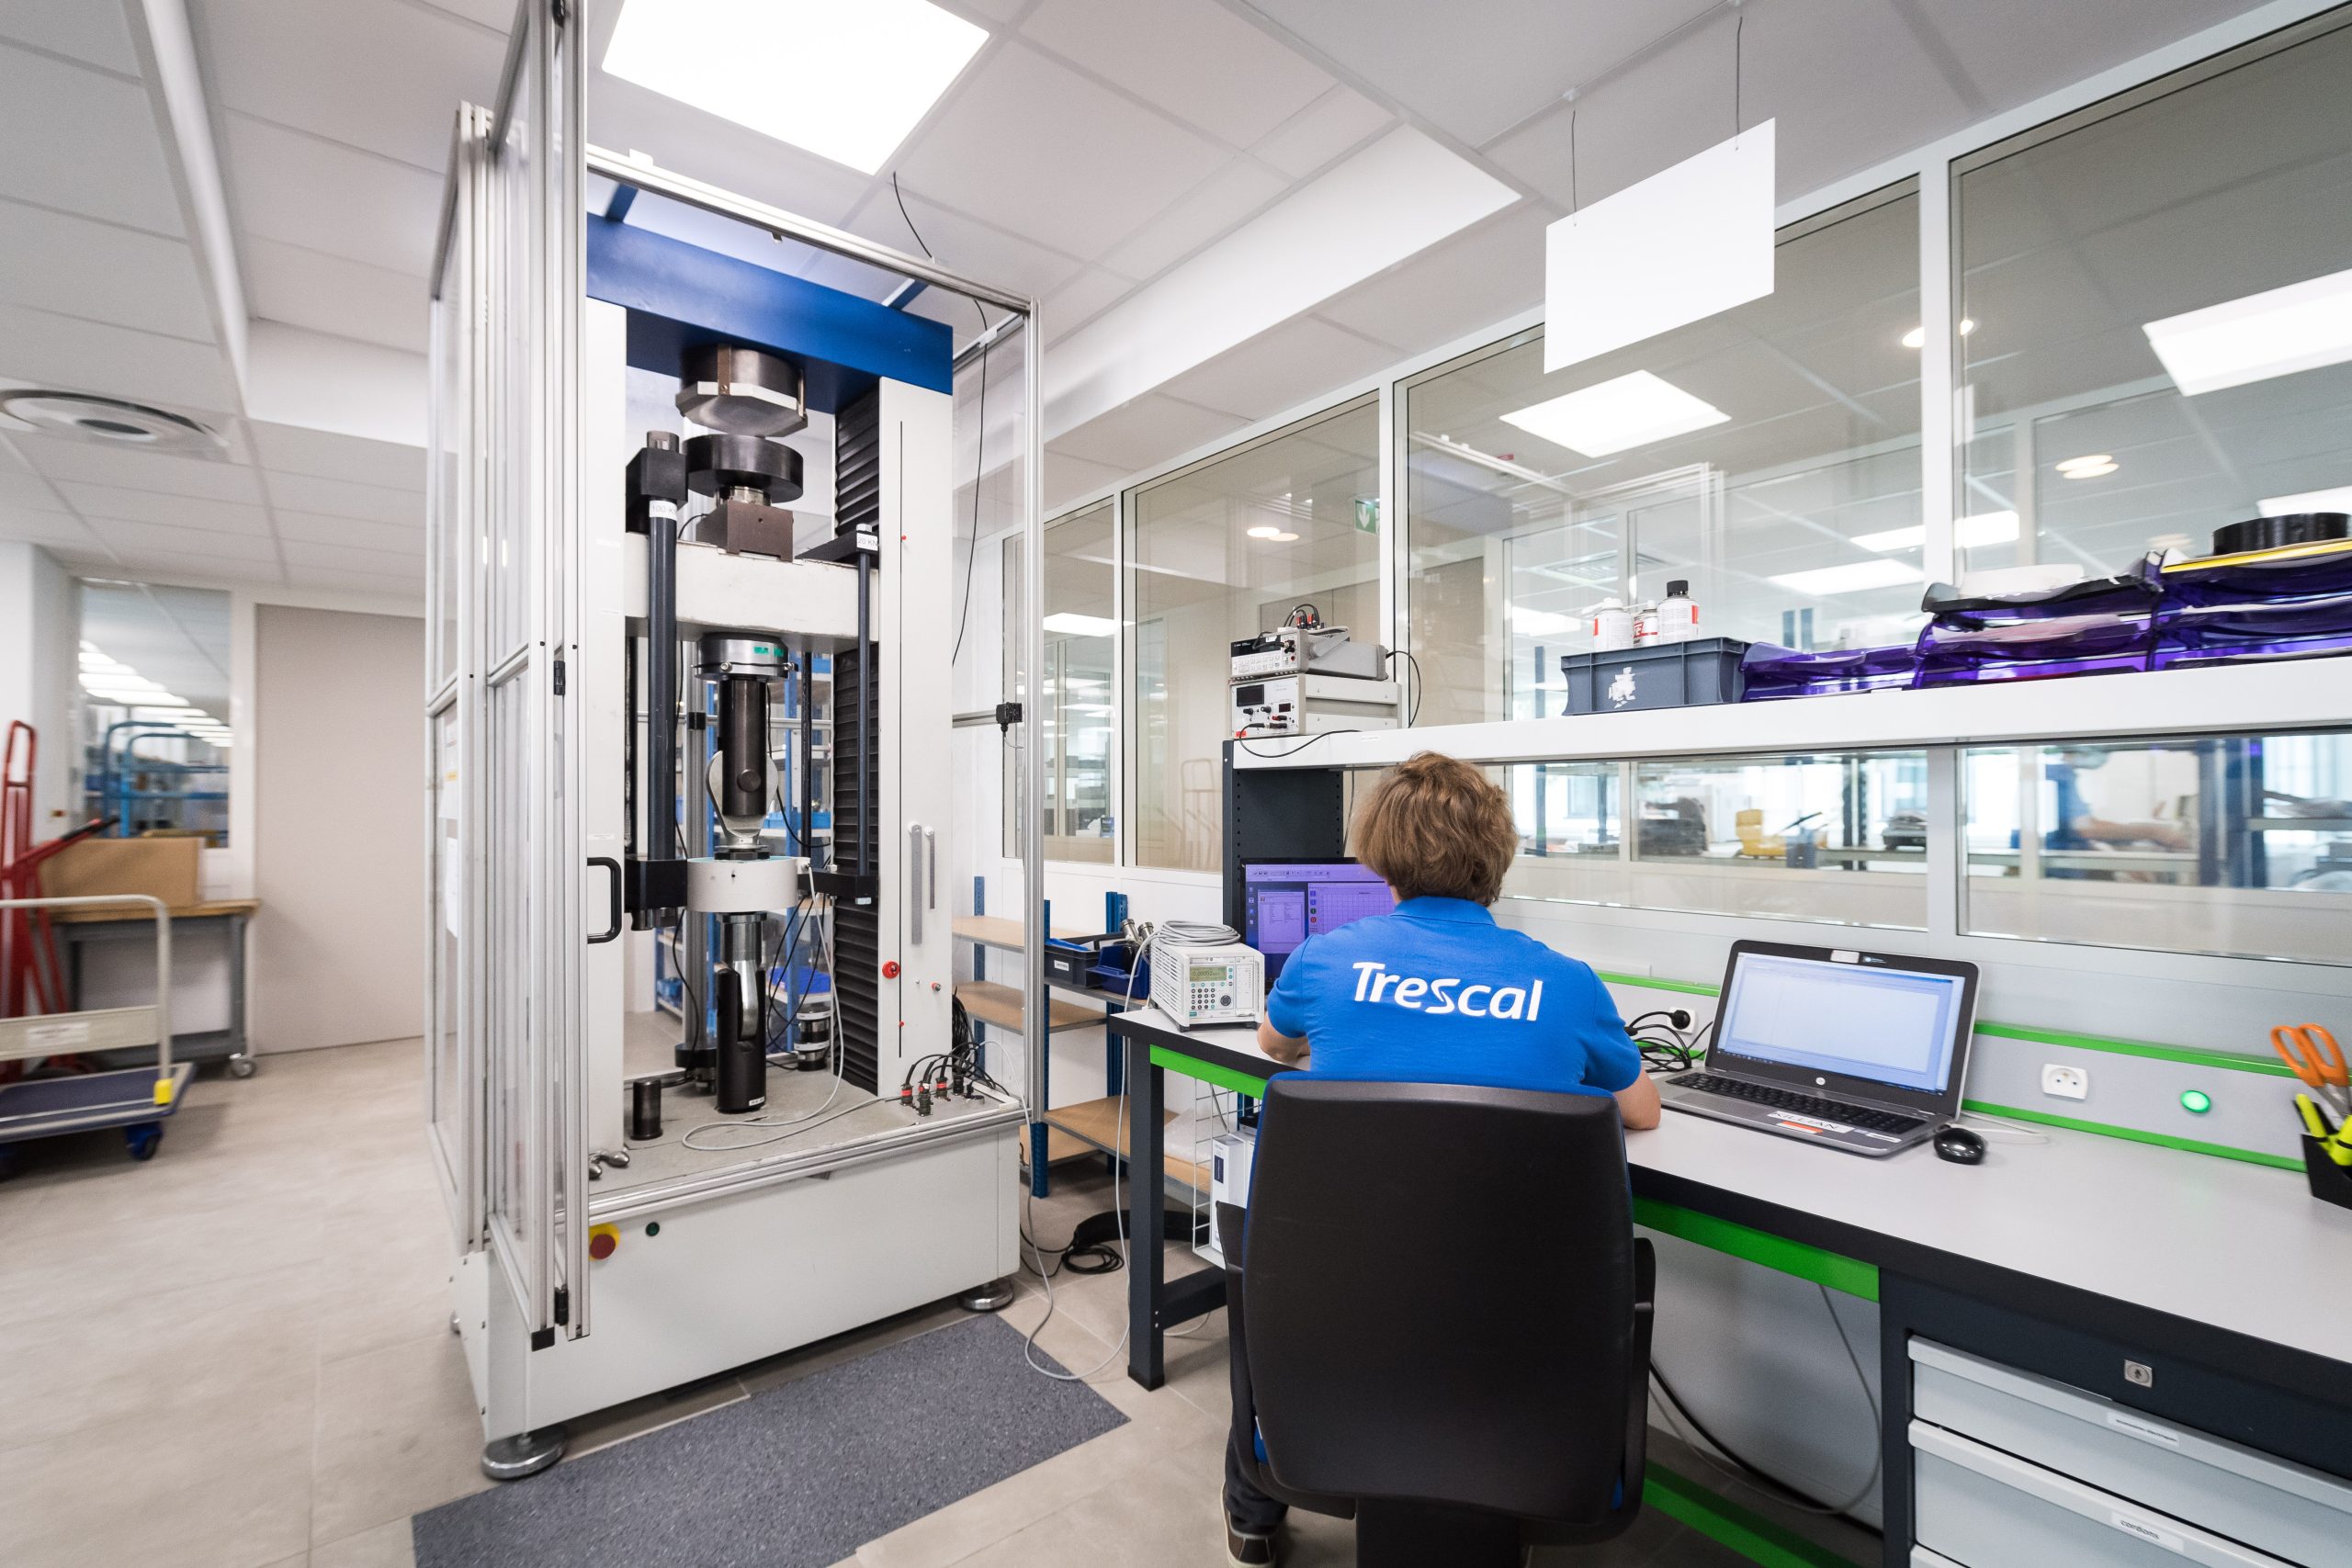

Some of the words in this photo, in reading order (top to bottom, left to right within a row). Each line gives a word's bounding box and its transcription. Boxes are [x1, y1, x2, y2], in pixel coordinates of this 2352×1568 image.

[652, 505, 666, 513] 100
[857, 536, 866, 545] 20
[1352, 962, 1543, 1021] Trescal
